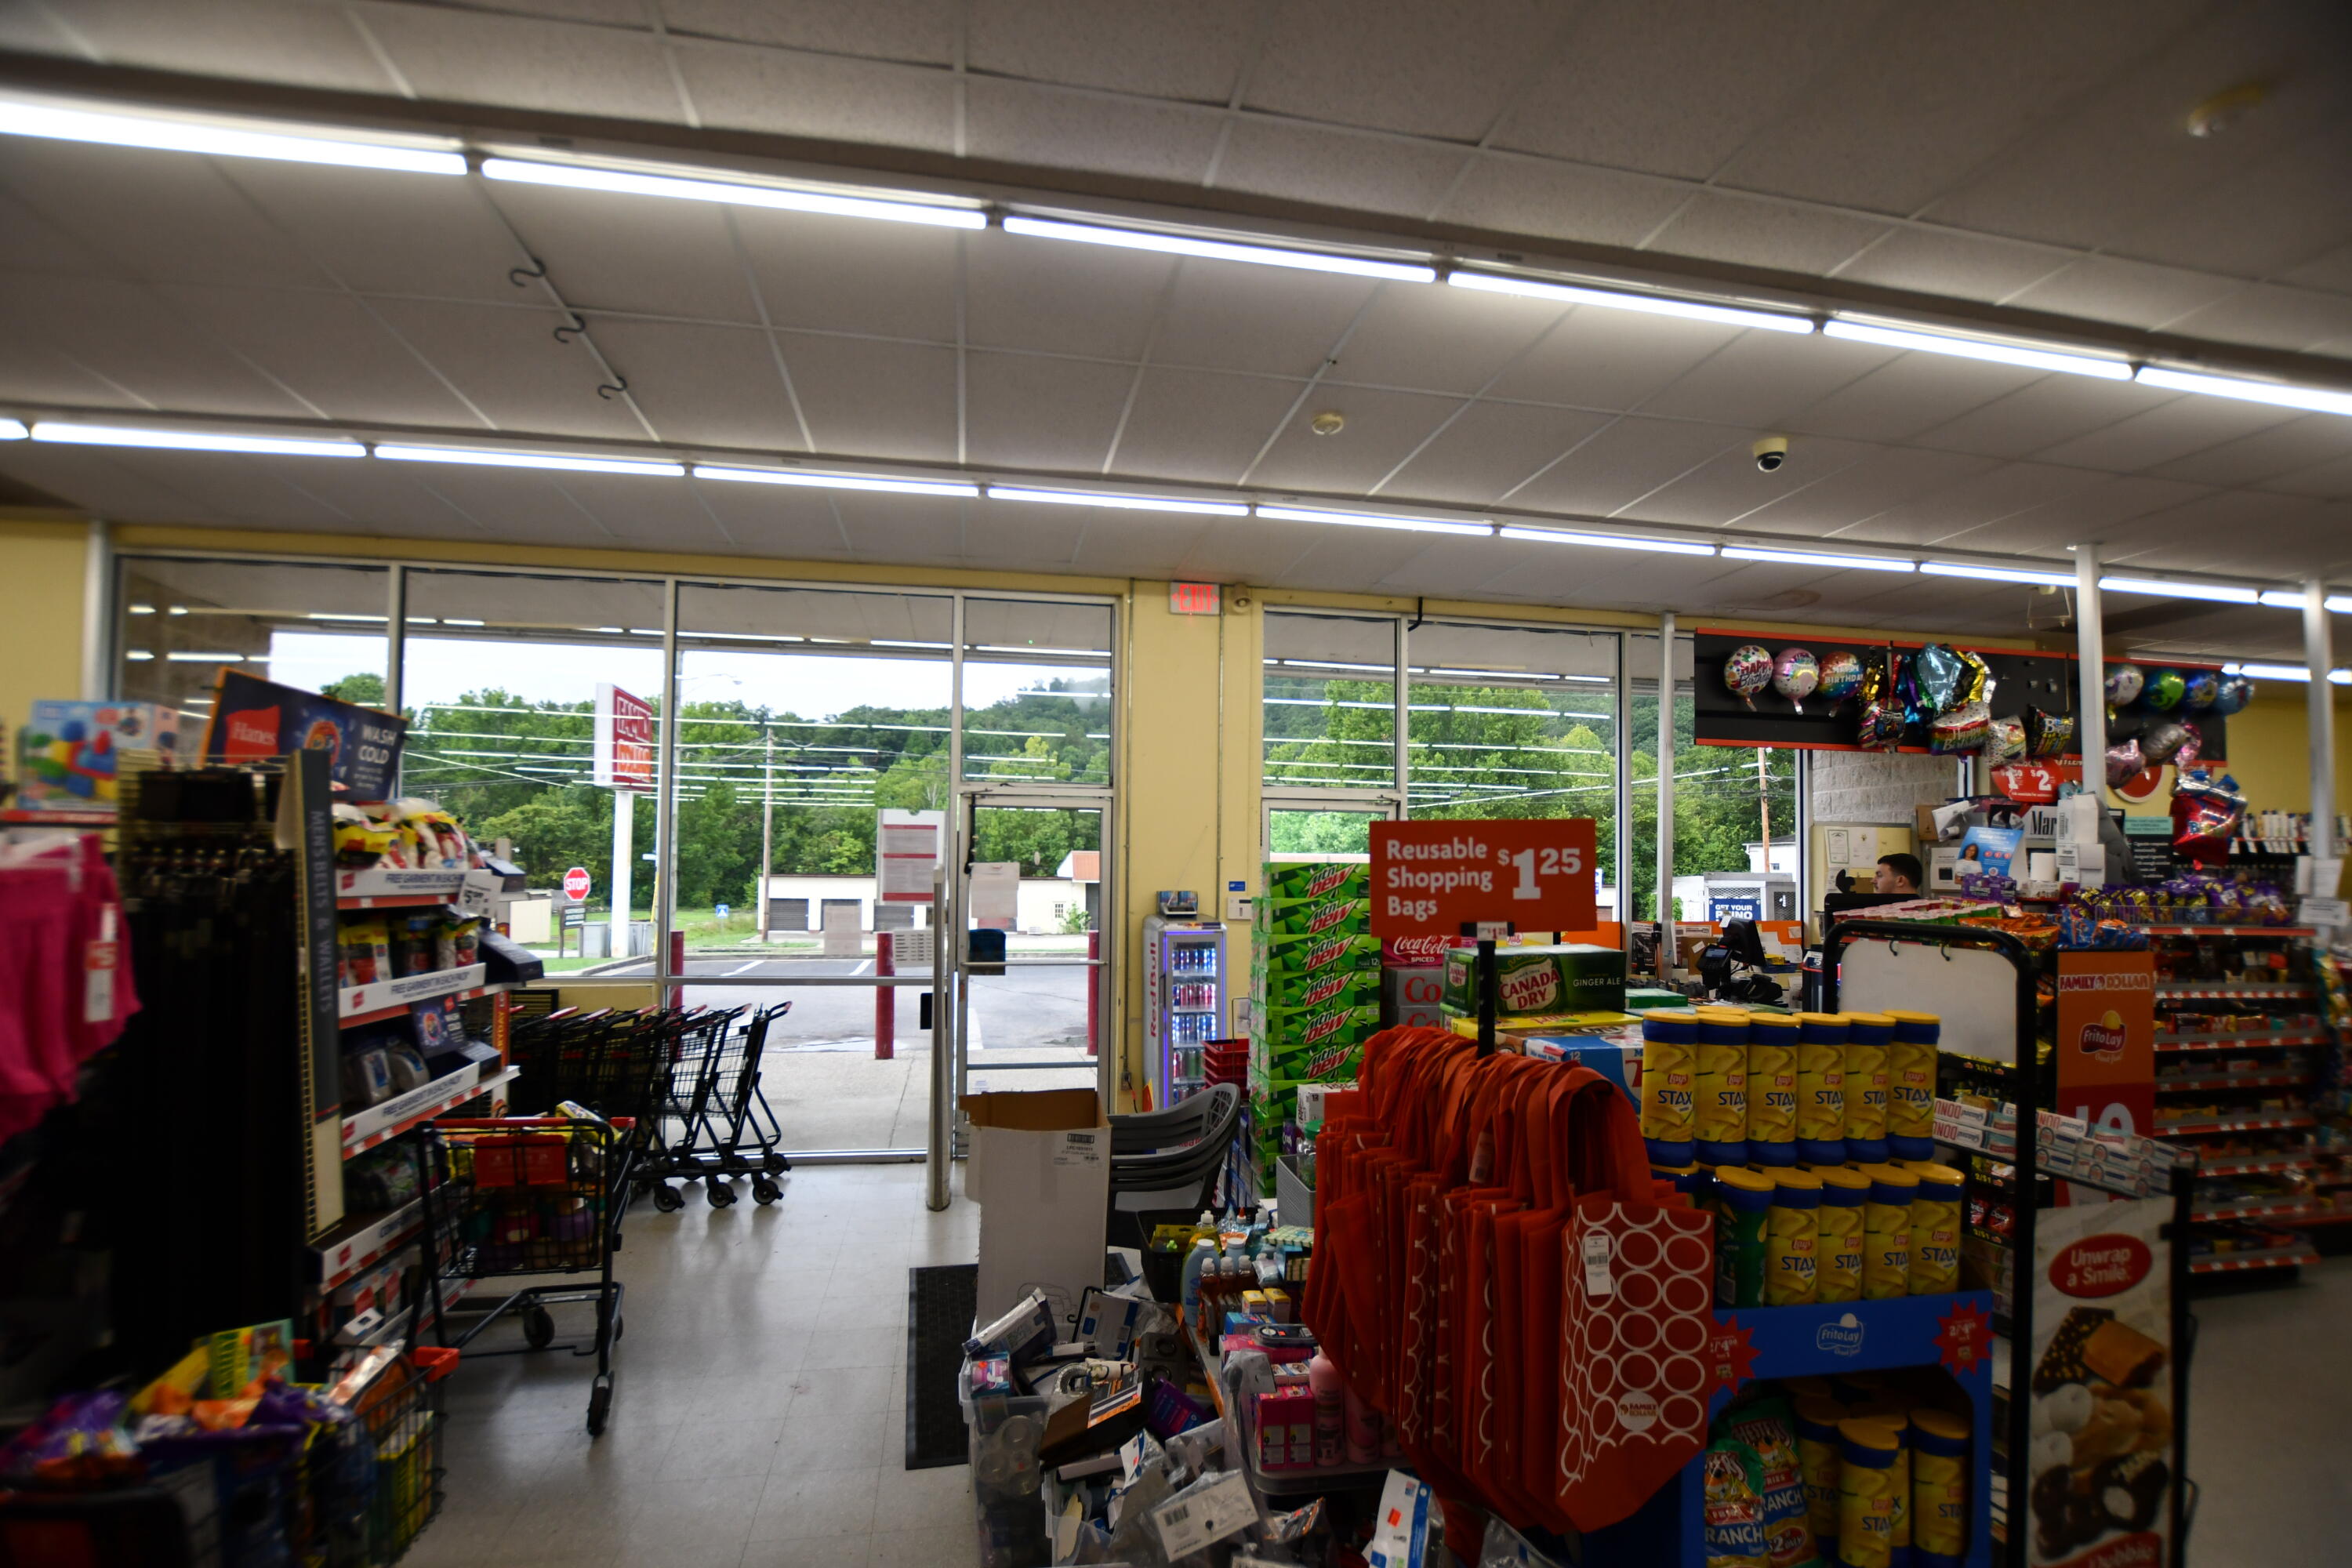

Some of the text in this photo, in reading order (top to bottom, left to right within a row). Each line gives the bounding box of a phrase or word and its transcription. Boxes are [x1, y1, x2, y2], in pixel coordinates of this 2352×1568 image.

[1178, 584, 1214, 612] EXIT
[361, 724, 397, 746] WASH
[358, 746, 390, 764] COLD
[2032, 811, 2057, 835] Mar
[310, 811, 325, 857] MENS
[1387, 837, 1487, 860] Reusable
[314, 862, 328, 908] BELTS
[565, 877, 588, 891] STOP
[1387, 866, 1493, 894] Shopping
[1388, 896, 1438, 922] Bags
[318, 940, 334, 1013] WALLETS
[1498, 968, 1560, 1000] CANADA
[1573, 977, 1621, 987] GINGER ALE
[2059, 973, 2149, 990] FAMILY DOLLAR
[1404, 977, 1442, 1003] Co
[1517, 989, 1548, 1009] DRY
[1657, 1090, 1693, 1105] STAX
[1863, 1091, 1887, 1105] STA
[1893, 1087, 1932, 1102] STAX
[1934, 1099, 1961, 1119] DONU
[1780, 1255, 1817, 1272] STAX
[1883, 1252, 1907, 1266] STA
[1921, 1247, 1958, 1261] STAX
[2070, 1247, 2132, 1269] Unwrap
[2066, 1272, 2078, 1288] a
[1705, 1525, 1762, 1546] RANCH
